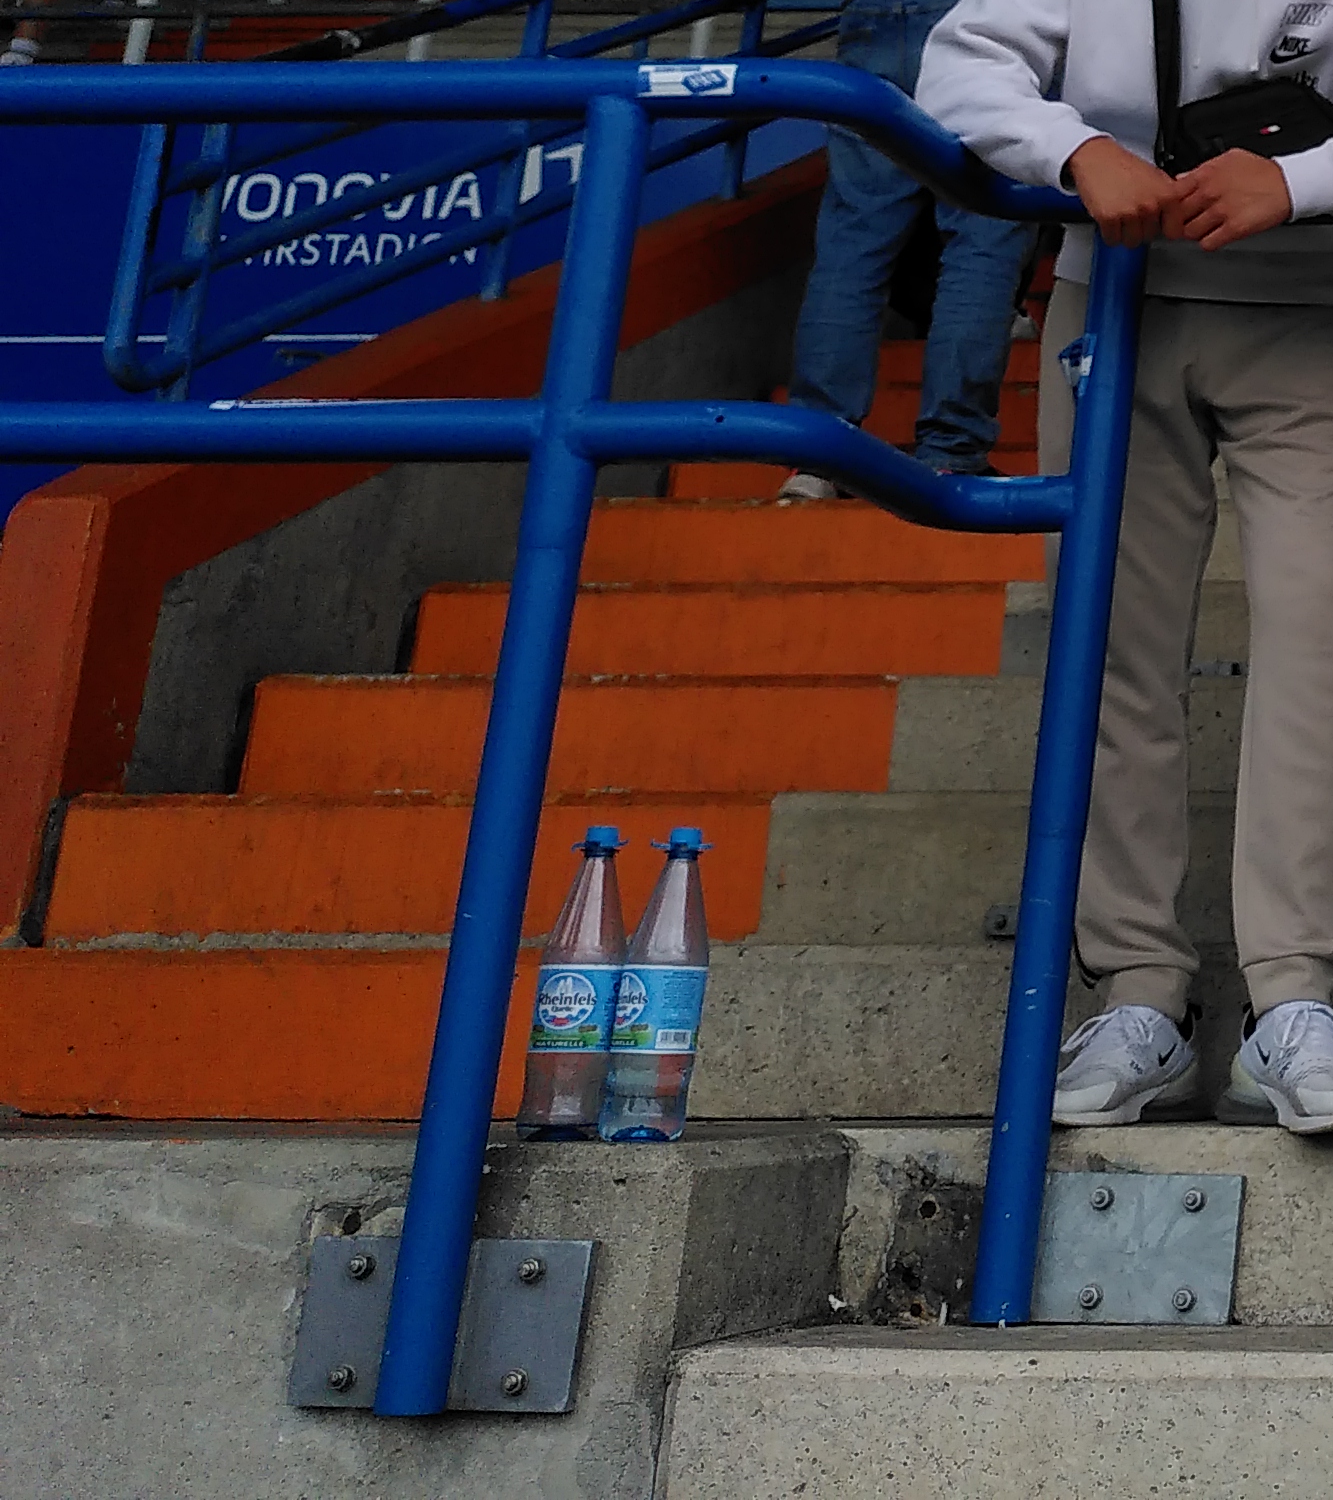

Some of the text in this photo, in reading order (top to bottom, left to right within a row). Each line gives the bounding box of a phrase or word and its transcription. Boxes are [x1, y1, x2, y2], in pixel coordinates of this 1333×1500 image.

[1281, 3, 1333, 26] NIKE
[1278, 35, 1311, 52] NIKE
[539, 992, 597, 1006] Rheinfels
